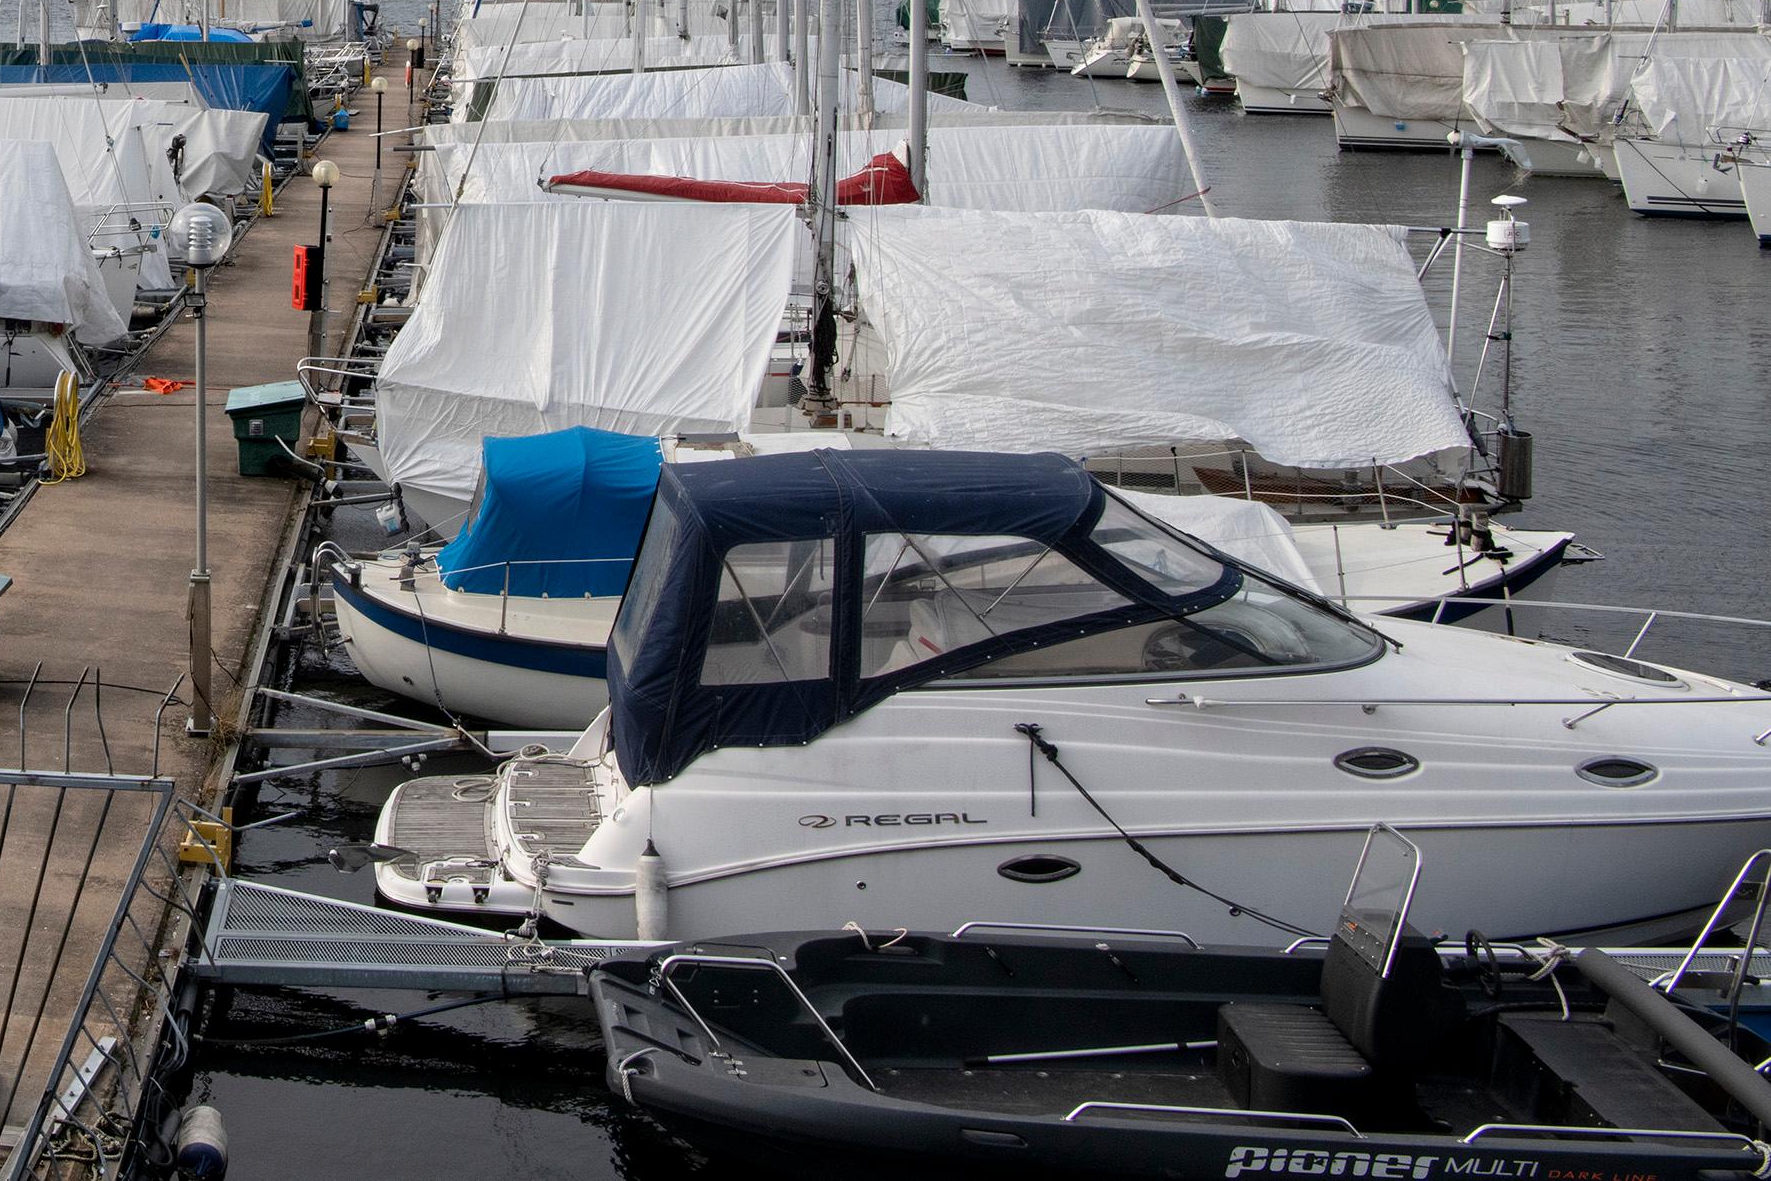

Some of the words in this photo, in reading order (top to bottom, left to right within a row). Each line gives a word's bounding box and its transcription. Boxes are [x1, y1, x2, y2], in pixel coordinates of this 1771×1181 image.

[844, 812, 988, 827] REGAL
[1224, 1145, 1440, 1180] pioner
[1444, 1156, 1539, 1178] MULTI
[1548, 1169, 1605, 1181] DARK
[1612, 1171, 1658, 1181] LINE
